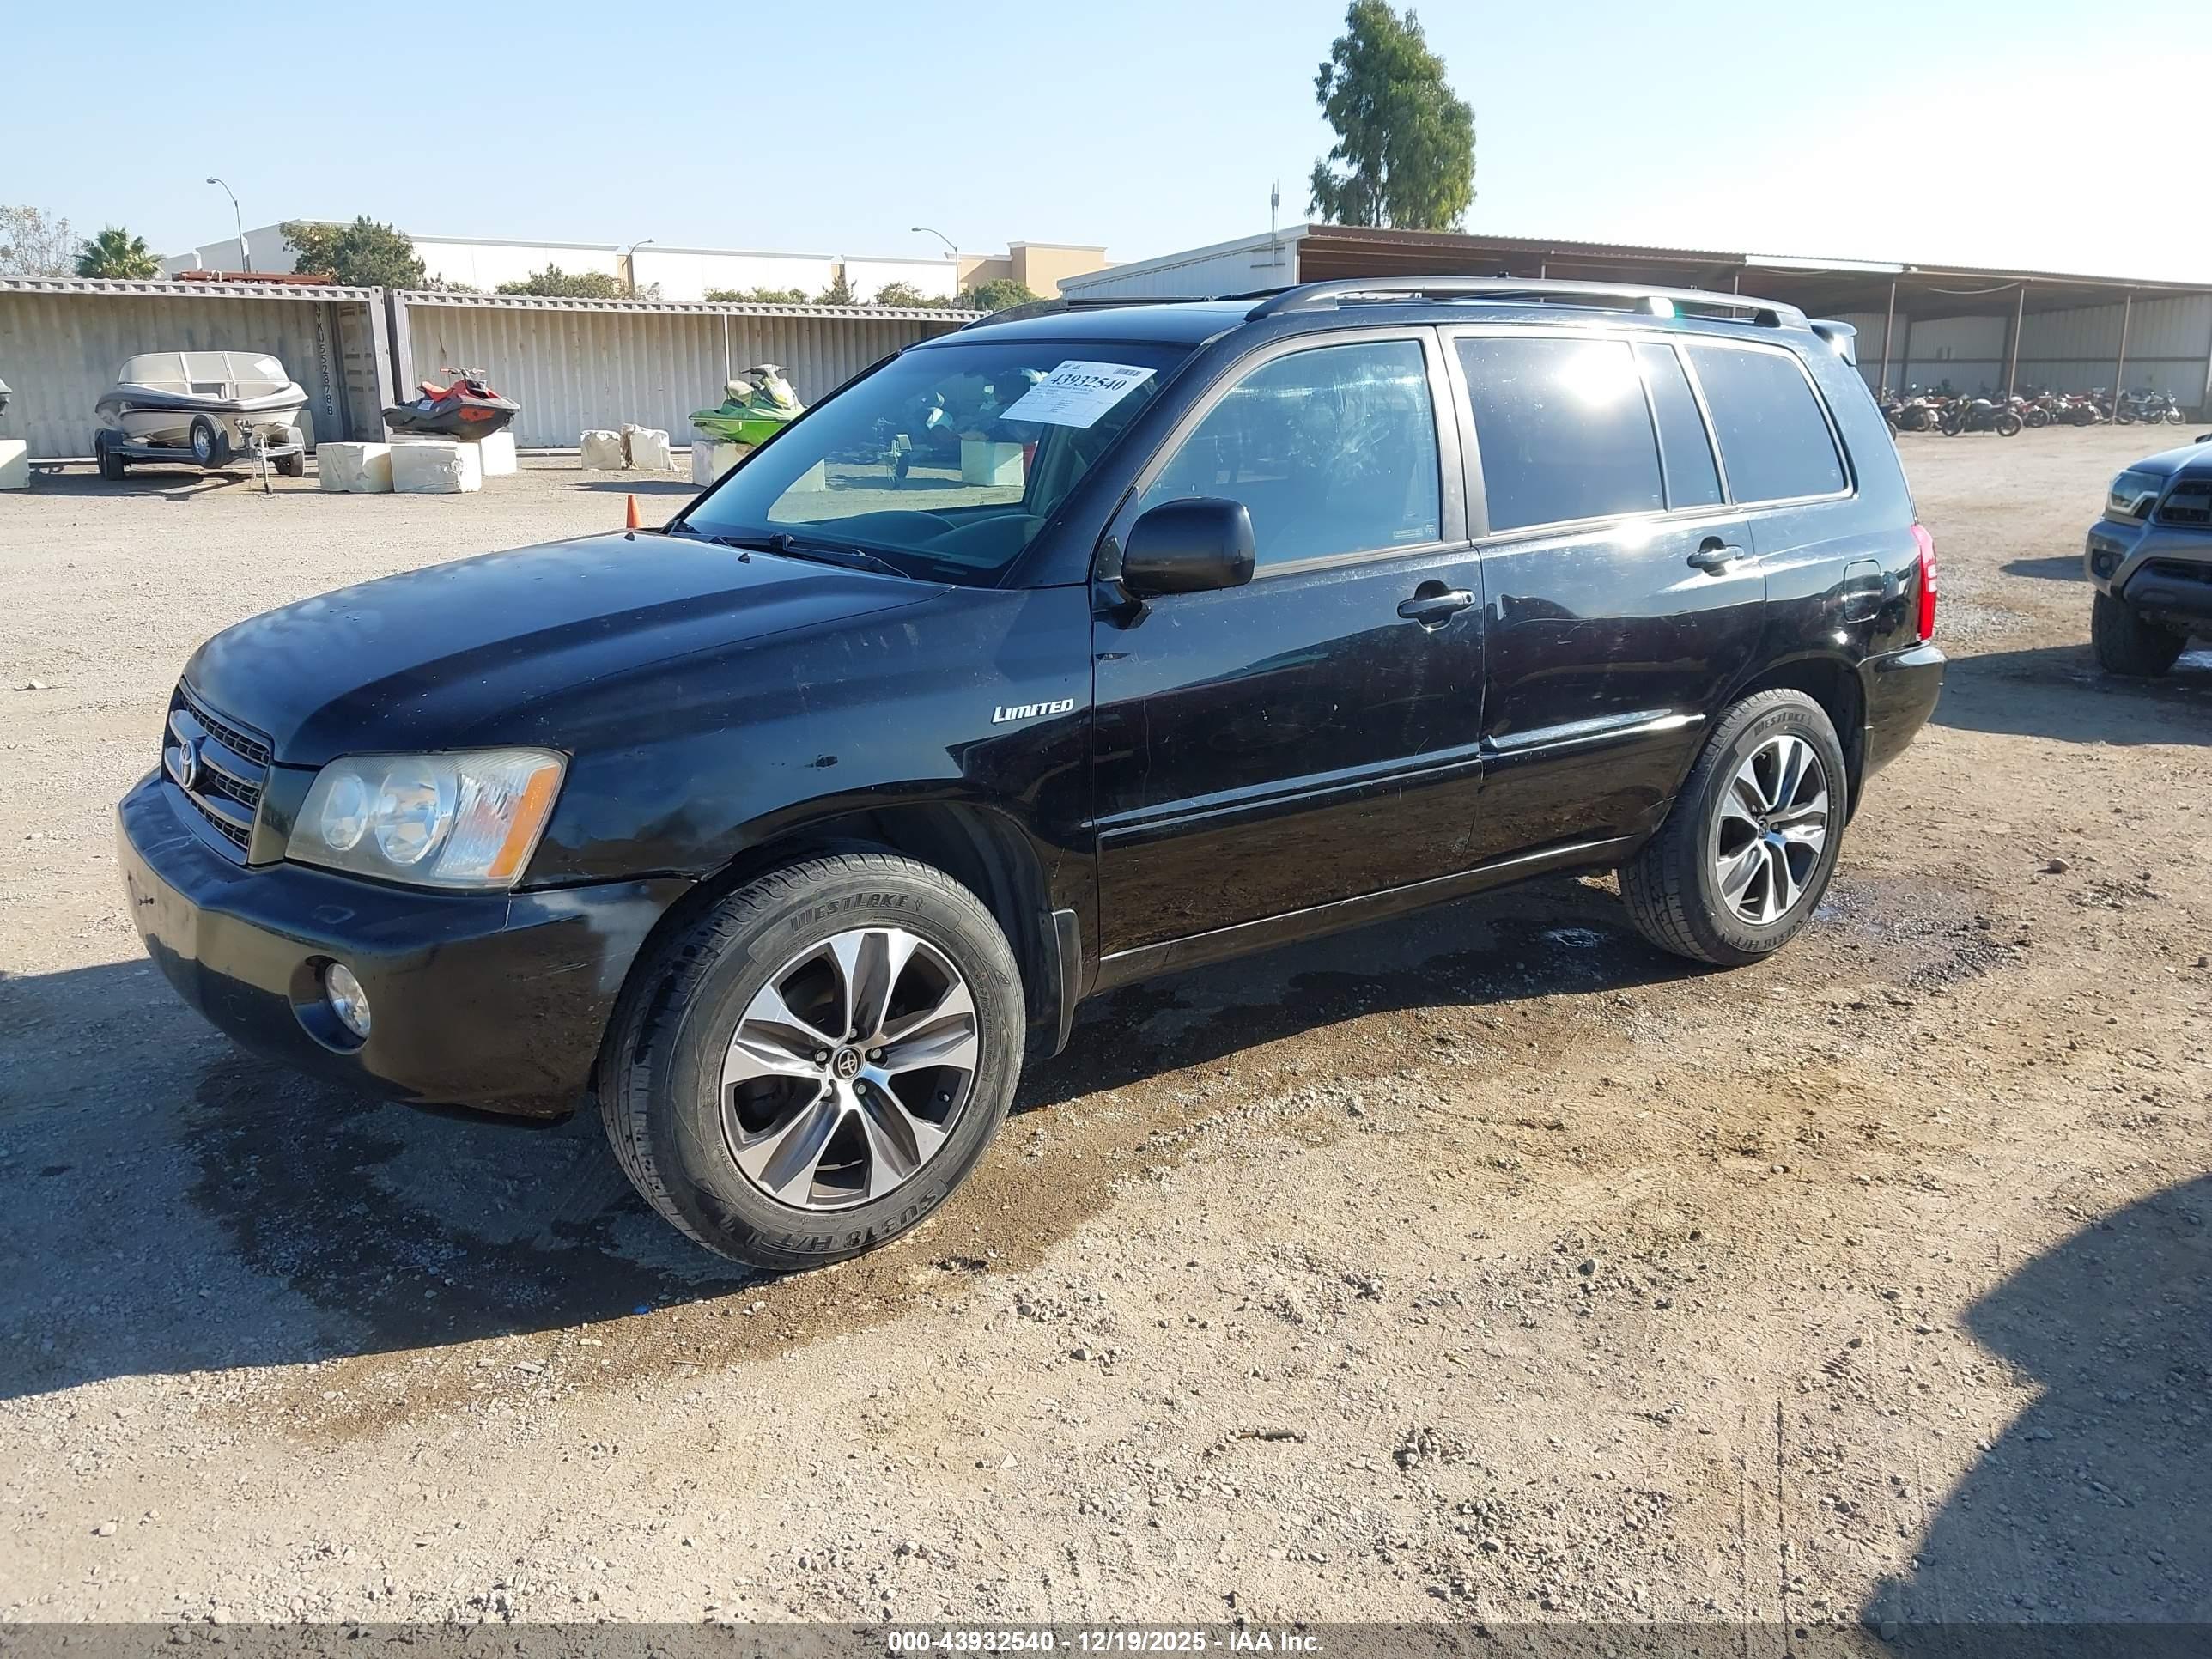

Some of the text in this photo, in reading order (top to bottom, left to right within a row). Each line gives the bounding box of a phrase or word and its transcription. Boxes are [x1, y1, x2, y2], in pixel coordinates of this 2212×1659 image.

[1050, 374, 1127, 392] 43932540
[991, 697, 1074, 725] LIMITED
[789, 892, 909, 935] WESTLAKE
[772, 1187, 939, 1251] SU318 H/T
